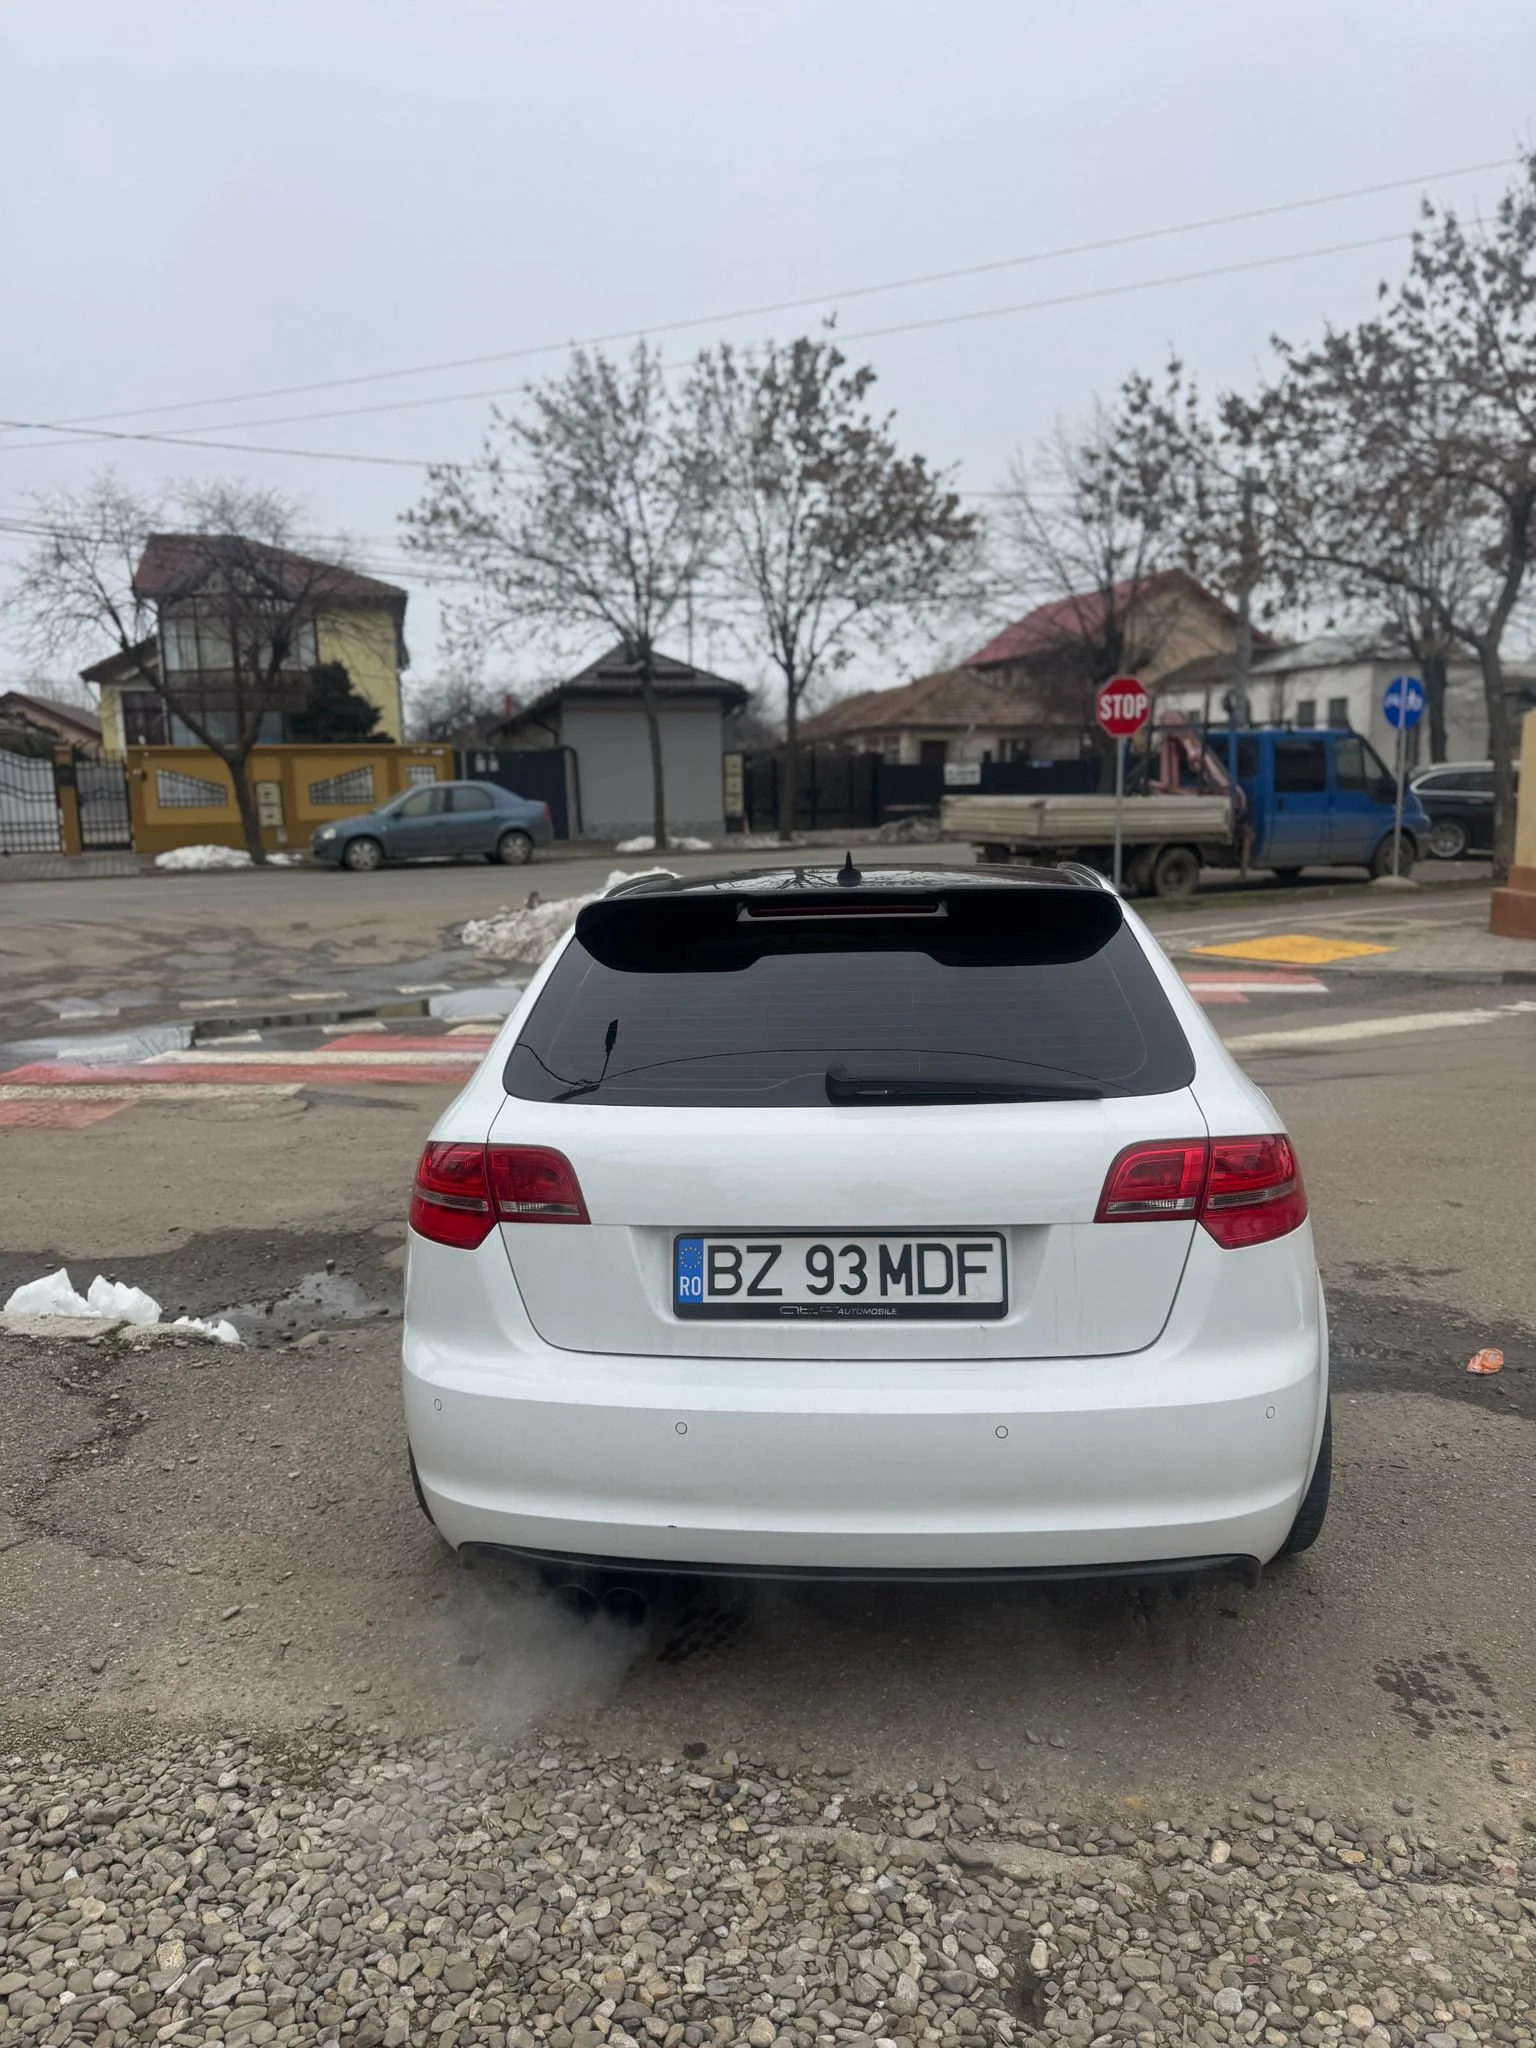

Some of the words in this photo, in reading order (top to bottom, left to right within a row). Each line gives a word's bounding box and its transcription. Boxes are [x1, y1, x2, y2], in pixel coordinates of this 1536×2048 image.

[1100, 693, 1147, 720] STOP
[708, 1245, 783, 1296] BZ
[805, 1244, 868, 1296] 93
[880, 1243, 993, 1297] MDF
[680, 1276, 702, 1296] RO
[837, 1307, 897, 1316] AUTOMOBILE
